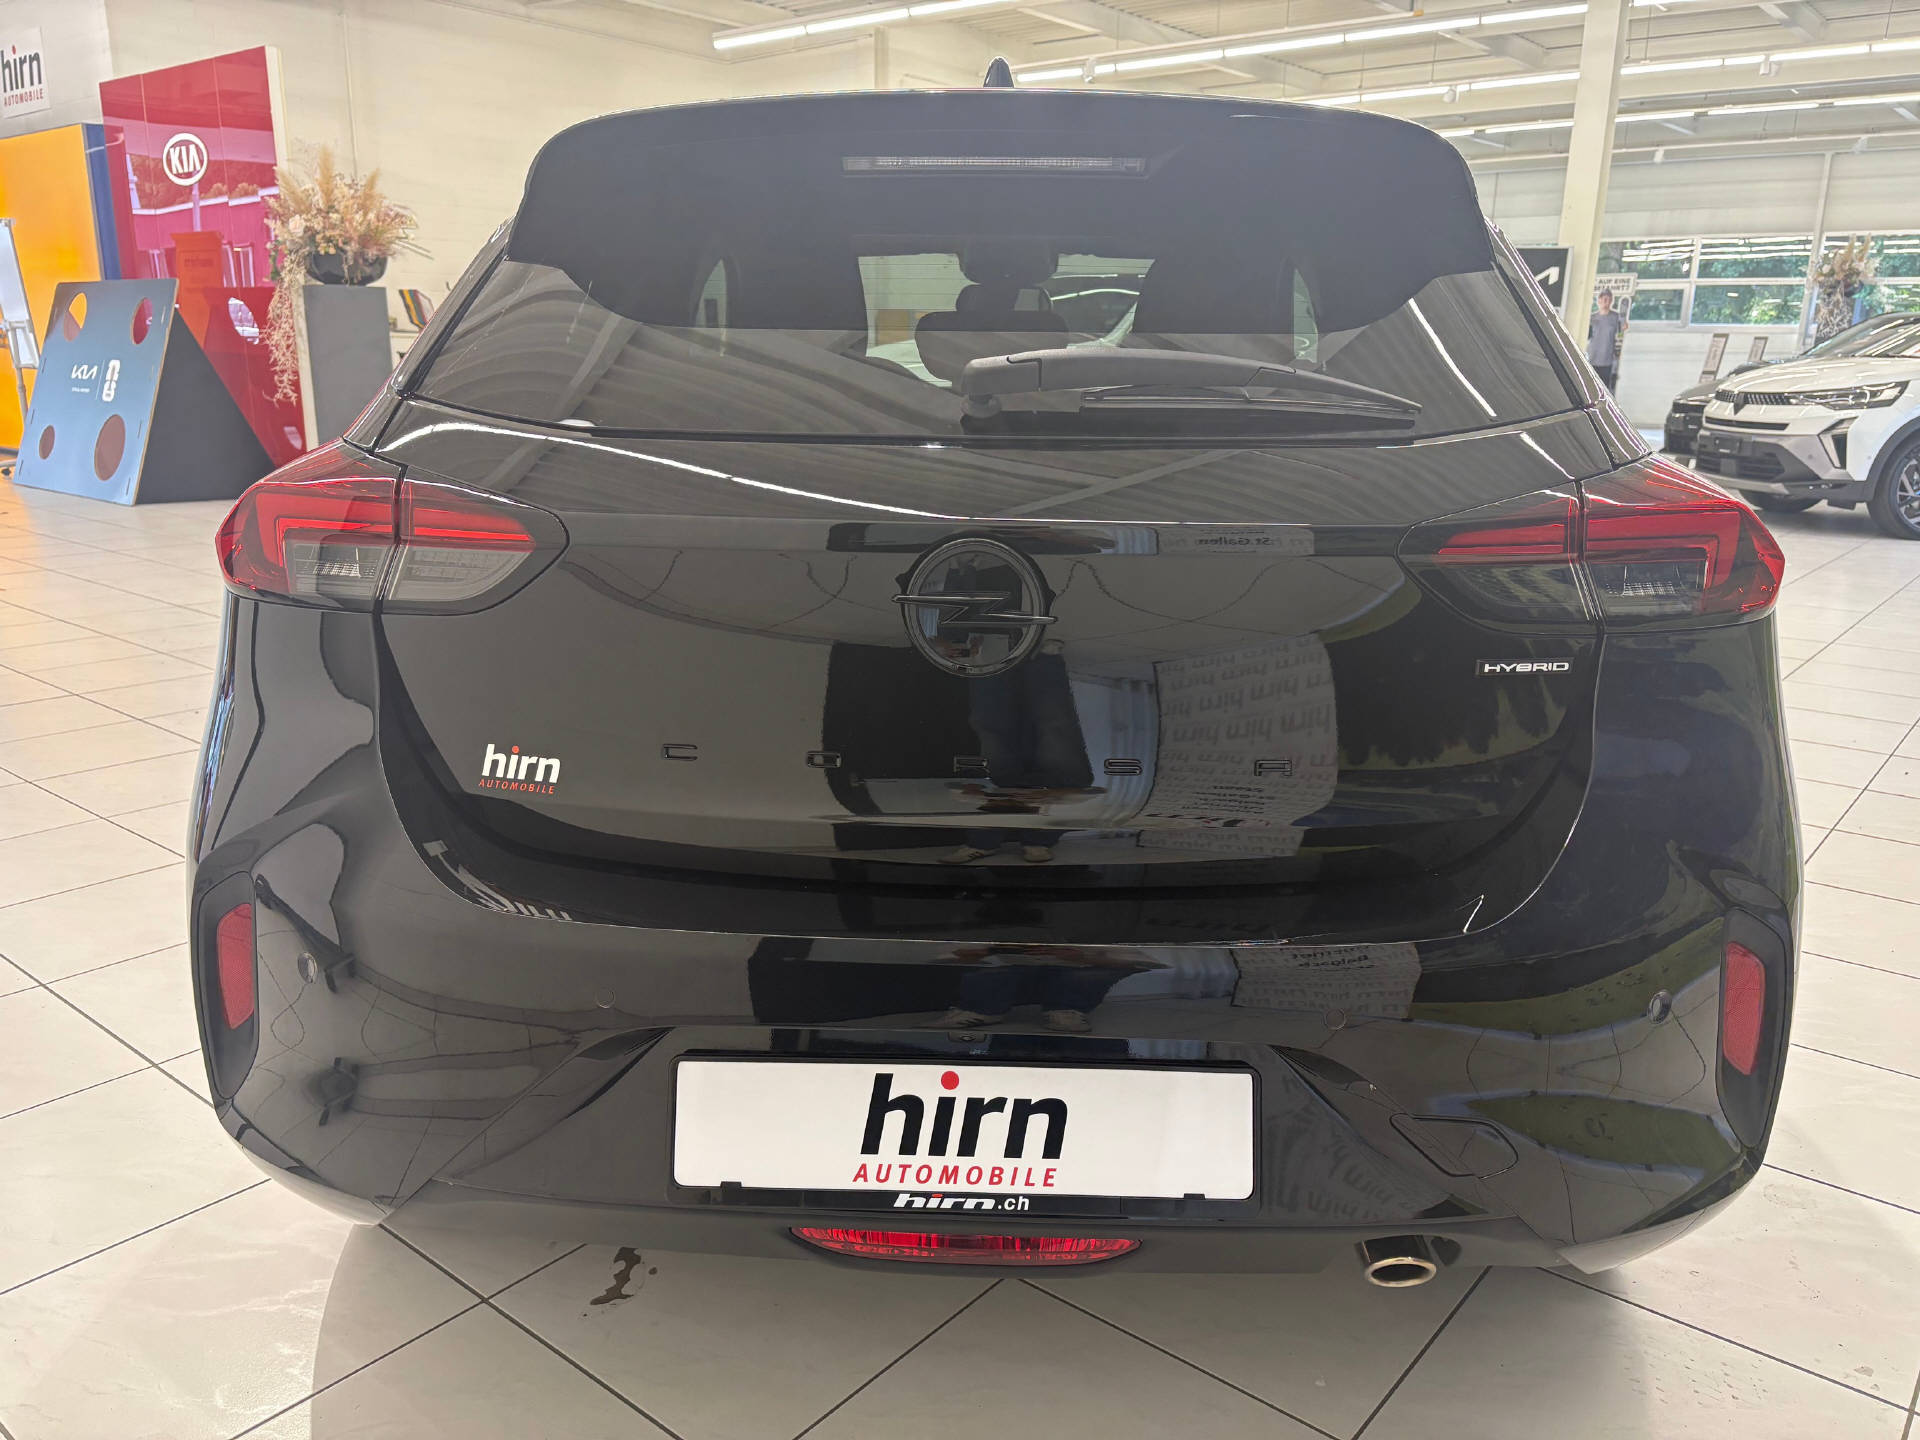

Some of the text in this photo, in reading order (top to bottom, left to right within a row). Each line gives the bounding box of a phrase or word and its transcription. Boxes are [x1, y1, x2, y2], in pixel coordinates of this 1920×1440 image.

[0, 44, 42, 93] hirn
[3, 88, 44, 107] AUTOMOBILE
[169, 143, 201, 175] KIA
[71, 364, 98, 380] KIA
[1483, 662, 1570, 673] HYBRID
[482, 743, 561, 784] hirn
[661, 743, 1294, 777] CORSA
[478, 778, 556, 795] AUTOMOBILE
[860, 1070, 1069, 1160] hirn
[852, 1163, 1058, 1188] AUTOMOBILE
[892, 1192, 1030, 1212] hirn.ch
